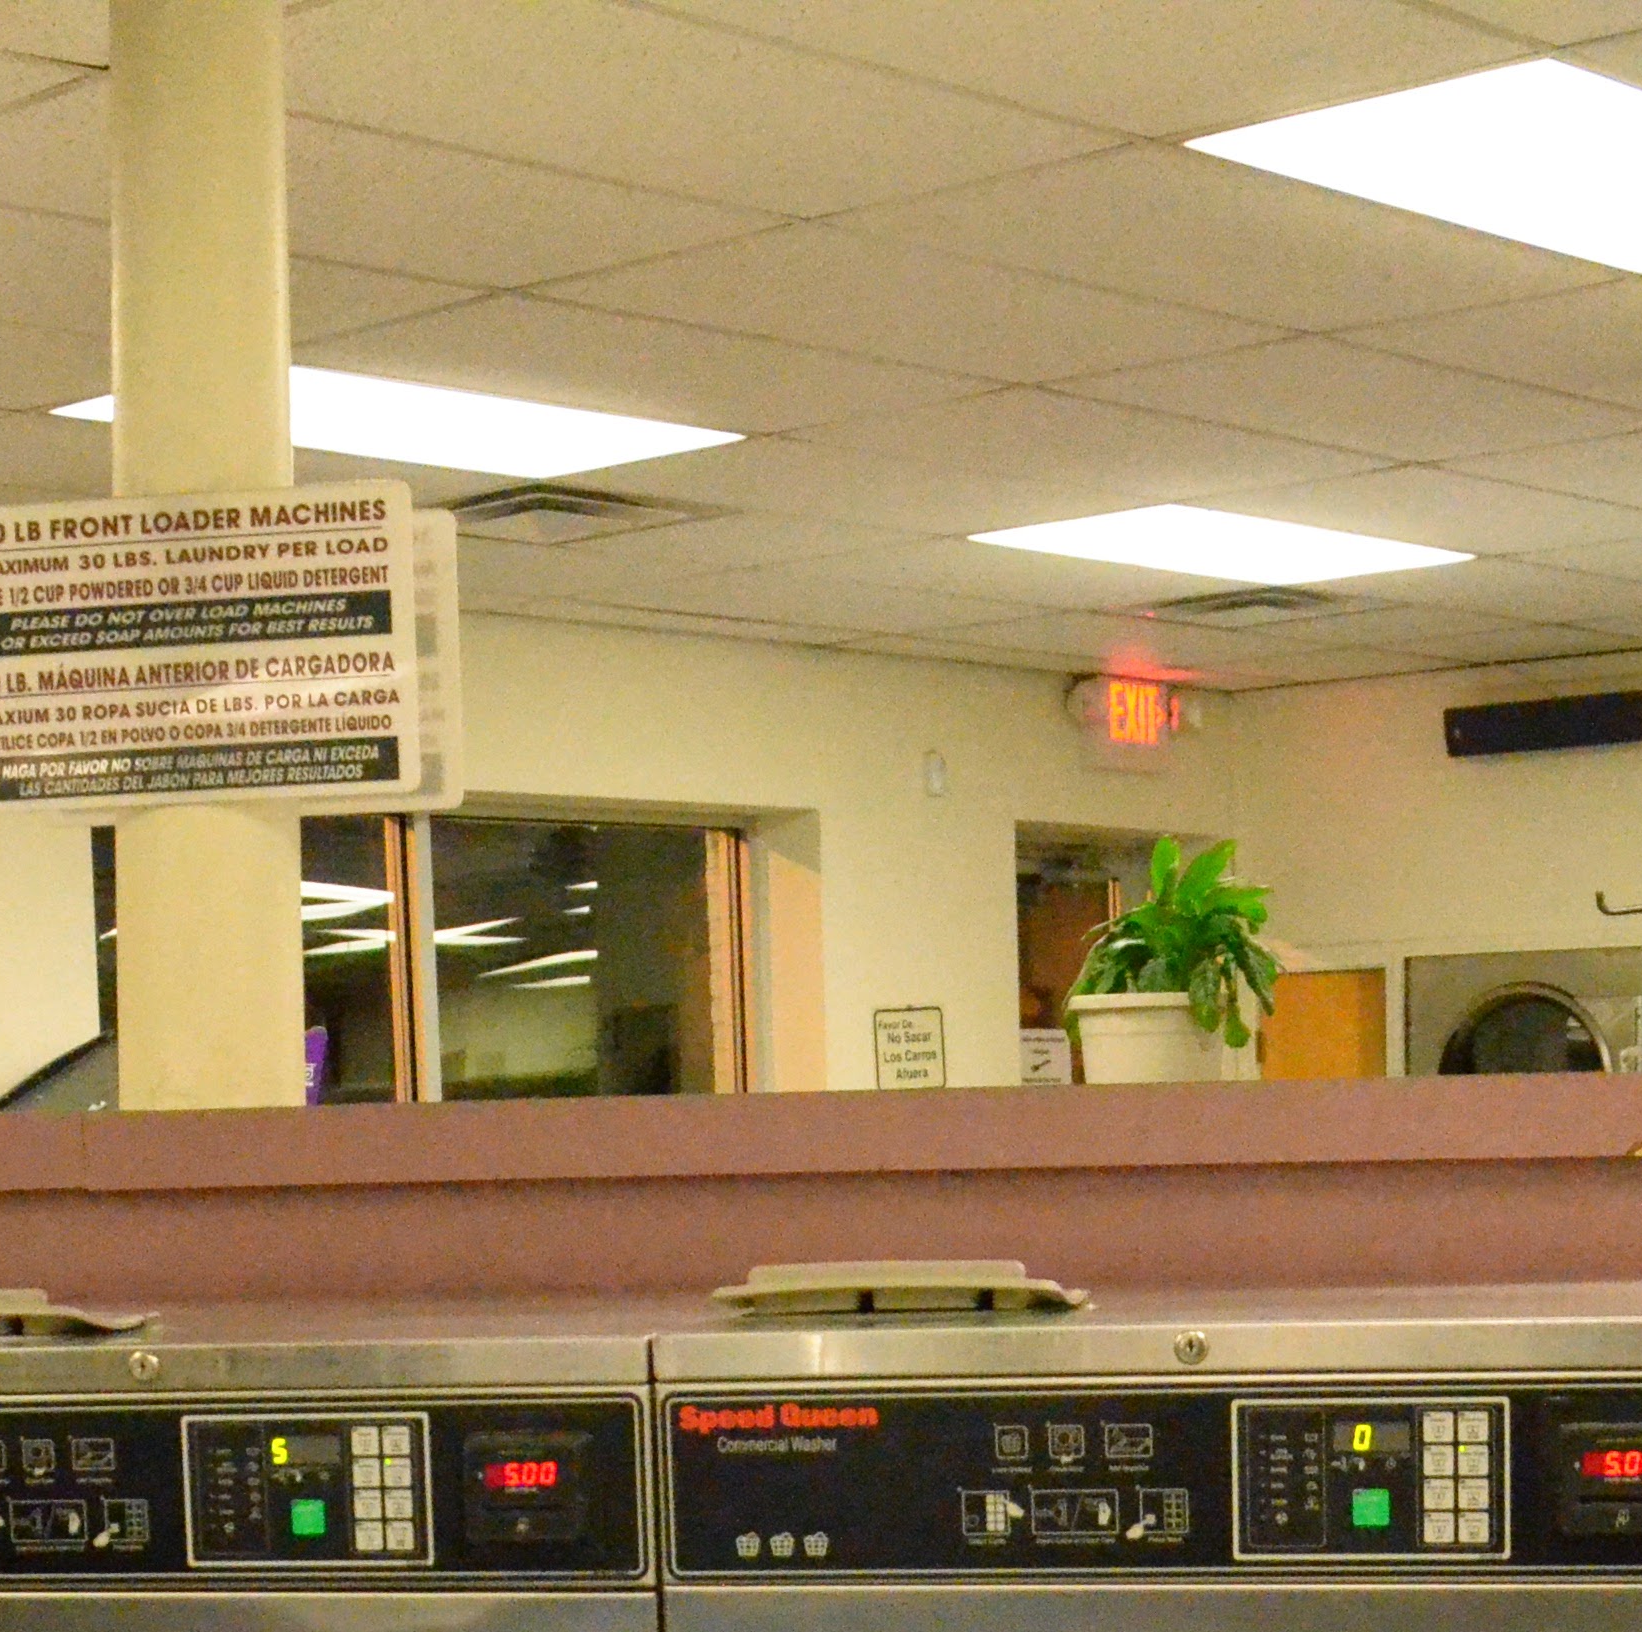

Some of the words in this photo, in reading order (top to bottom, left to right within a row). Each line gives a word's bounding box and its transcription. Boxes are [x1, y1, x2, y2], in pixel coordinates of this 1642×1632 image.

[14, 520, 41, 543] LB
[49, 515, 132, 541] FRONT
[140, 508, 240, 535] LOADER
[250, 499, 386, 529] MACHINES
[78, 555, 105, 570] 30
[113, 551, 157, 568] LBS.
[165, 544, 270, 565] LAUNDRY
[277, 541, 317, 559] PER
[326, 537, 388, 556] LOAD
[9, 587, 28, 605] 1/2
[33, 585, 64, 604] CUP
[69, 580, 153, 602] POWDERED
[158, 578, 180, 597] OR
[185, 576, 206, 595] 3/4
[211, 574, 243, 594] CUP
[248, 571, 298, 592] LIQUID
[303, 565, 388, 588] DETERGENT
[10, 615, 70, 631] PLEASE
[74, 613, 103, 627] DO
[107, 610, 144, 626] NOT
[148, 608, 196, 623] OVER
[200, 605, 249, 620] LOAD
[252, 599, 347, 617] MACHINES
[0, 637, 25, 650] OR
[30, 633, 92, 648] EXCEED
[95, 630, 140, 645] SOAP
[142, 625, 224, 642] AMOUNTS
[228, 623, 262, 637] FOR
[265, 620, 305, 635] BEST
[307, 616, 375, 633] RESULTS
[7, 672, 31, 693] LB.
[38, 663, 130, 692] MÁQUINA
[135, 661, 229, 686] ANTERIOR
[235, 659, 259, 681] DE
[265, 652, 396, 679] CARGADORA
[56, 707, 76, 723] 30
[82, 704, 131, 721] ROPA
[136, 700, 190, 718] SUCIA
[196, 699, 217, 715] DE
[224, 697, 258, 713] LBS.
[264, 694, 301, 711] POR
[308, 693, 328, 709] LA
[334, 689, 400, 707] CARGA
[1109, 681, 1160, 744] EXIT
[37, 731, 75, 748] COPA
[80, 730, 97, 746] 1/2
[101, 729, 117, 745] EN
[122, 727, 165, 744] POLVO
[169, 726, 180, 741] O
[183, 724, 222, 741] COPA
[226, 722, 246, 738] 3/4
[250, 718, 331, 737] DETERGENTE
[2, 763, 36, 778] HAGA
[39, 762, 65, 776] POR
[68, 760, 107, 775] FAVOR
[111, 758, 131, 772] NO
[246, 752, 262, 766] DE
[265, 750, 307, 765] CARGA
[313, 749, 327, 762] NI
[331, 746, 379, 761] EXCEDA
[19, 782, 41, 796] LAS
[44, 778, 120, 795] CANTIDADES
[123, 776, 144, 790] DEL
[193, 772, 224, 787] PARA
[226, 769, 283, 785] MEJORES
[287, 765, 363, 782] RESULTADOS
[887, 1032, 901, 1043] No
[904, 1031, 931, 1043] Sacar
[884, 1052, 902, 1063] Los
[905, 1050, 936, 1061] Carros
[678, 1403, 775, 1436] Speed
[779, 1402, 879, 1427] Queen
[717, 1436, 788, 1453] Commercial
[791, 1435, 837, 1451] Washer
[1353, 1424, 1372, 1451] 0
